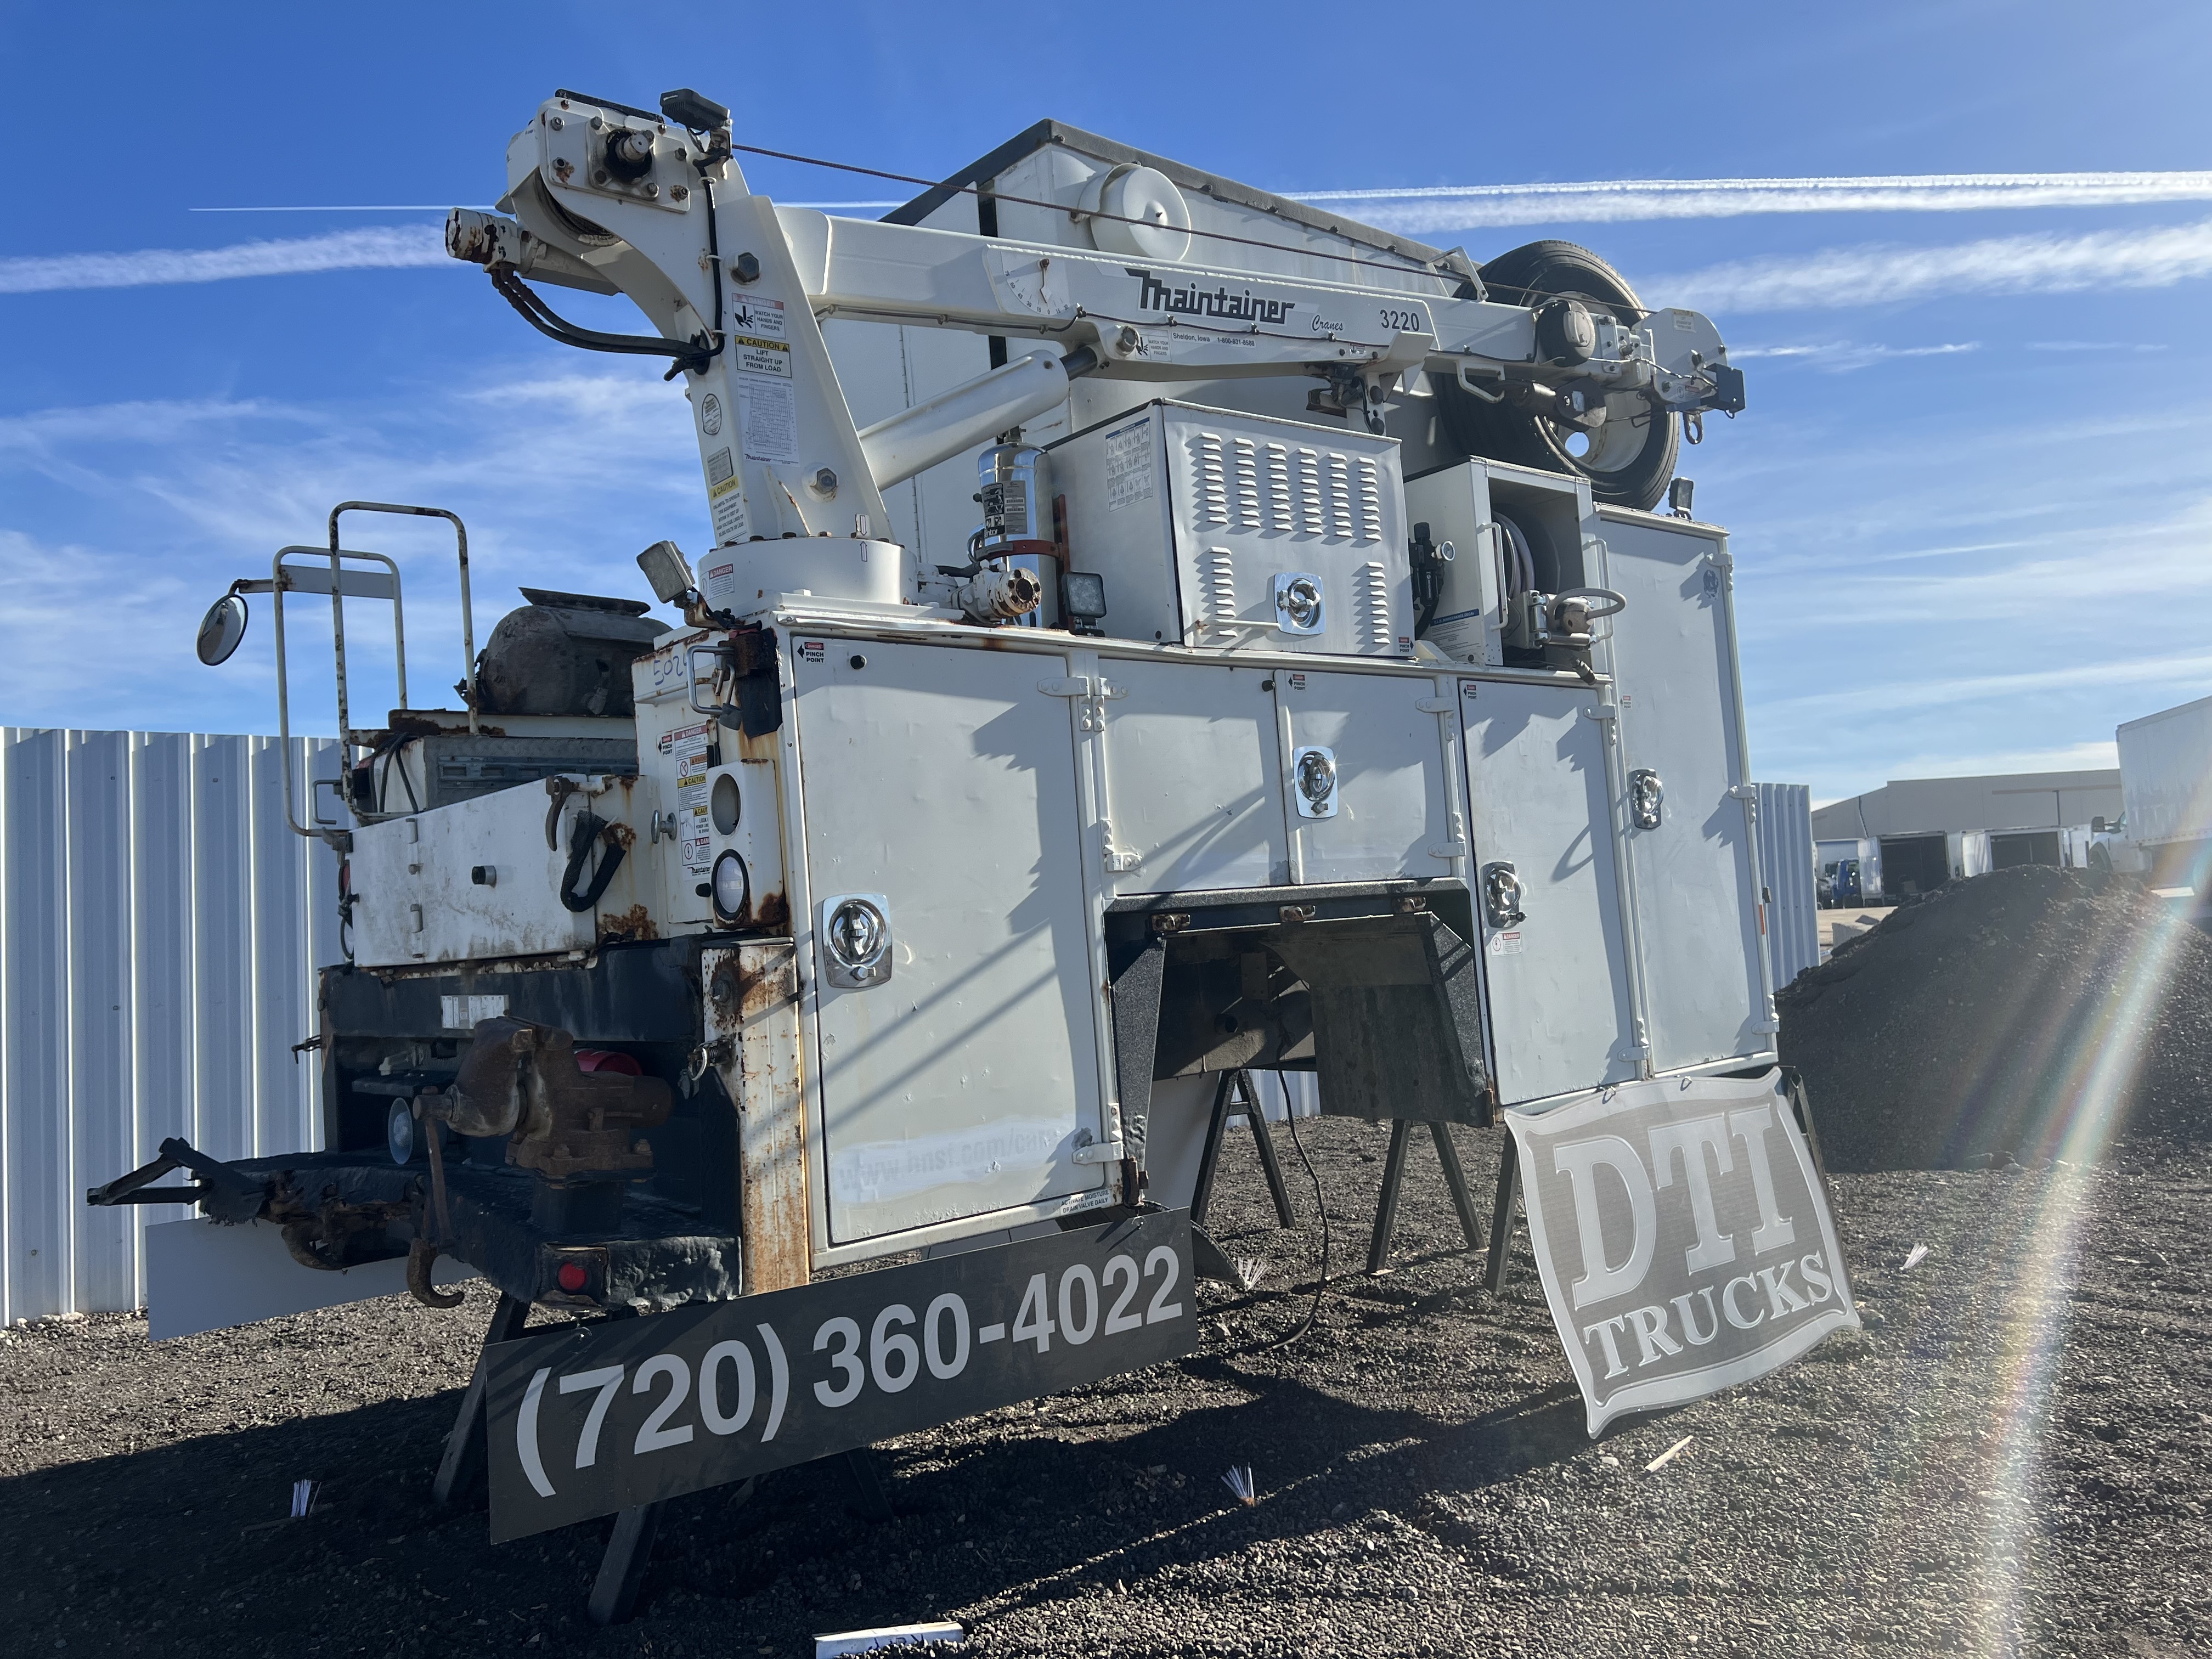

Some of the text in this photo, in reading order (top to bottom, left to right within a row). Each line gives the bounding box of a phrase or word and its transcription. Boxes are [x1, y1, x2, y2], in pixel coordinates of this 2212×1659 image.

[1124, 268, 1295, 324] Maintainer
[749, 298, 775, 307] DANGER
[1312, 315, 1344, 331] Cranes
[1380, 309, 1419, 331] 3220
[1173, 332, 1197, 342] Sheldon,
[747, 338, 780, 349] CAUTION
[743, 354, 773, 364] STRAIGHT
[744, 453, 771, 461] Maintainer
[716, 480, 736, 494] CAUTION
[713, 566, 732, 576] DANGER
[685, 727, 702, 736] DANGER
[688, 775, 706, 785] CAUTION
[1062, 1189, 1109, 1206] ACTIVATE MOISTURE
[1063, 1205, 1078, 1213] DRAIN
[1553, 1103, 1795, 1311] DTI
[1583, 1250, 1832, 1379] TRUCKS
[516, 1246, 1183, 1497] (720) 360-4022
